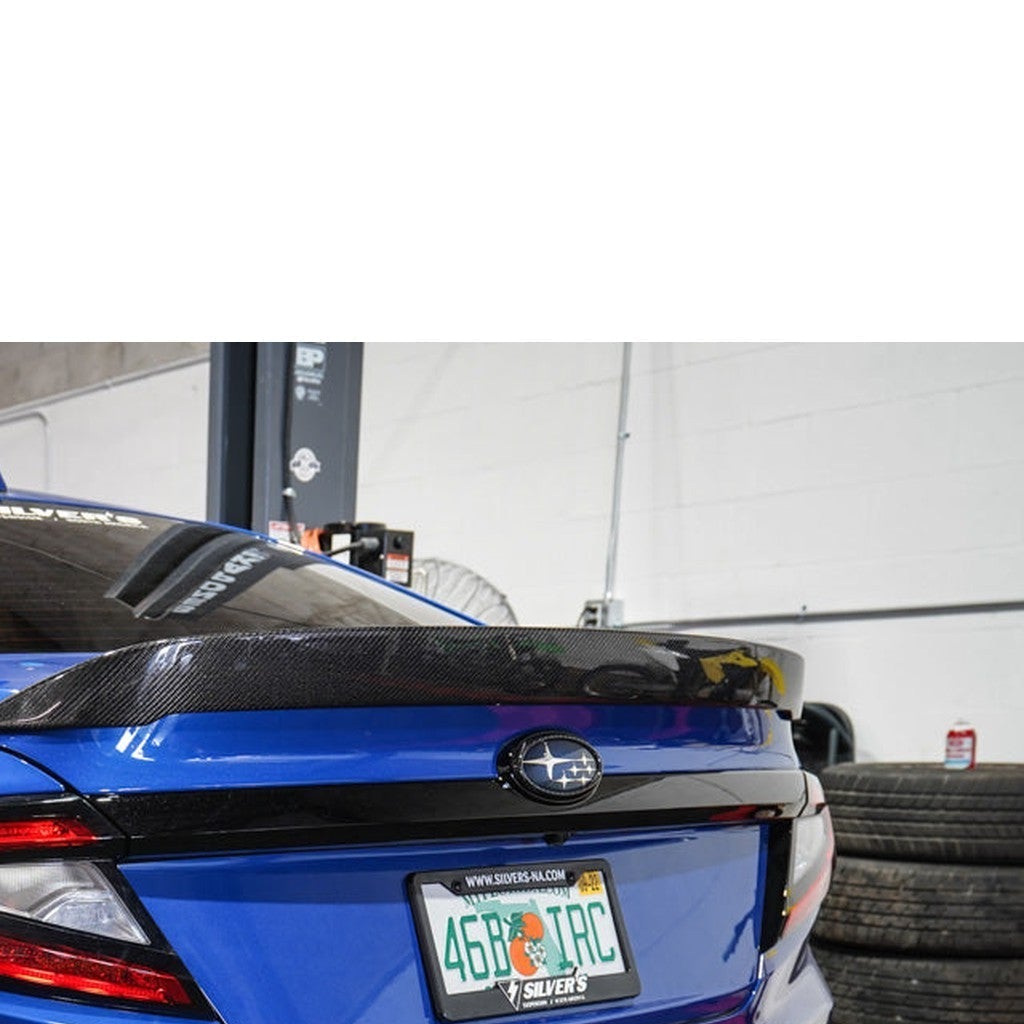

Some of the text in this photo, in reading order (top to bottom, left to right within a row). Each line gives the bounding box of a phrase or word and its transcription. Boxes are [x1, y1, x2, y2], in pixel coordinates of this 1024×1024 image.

[465, 869, 566, 887] WWW.SILVERS-NA.COM
[444, 902, 616, 982] 46B IRC
[523, 972, 588, 999] SILVER'S
